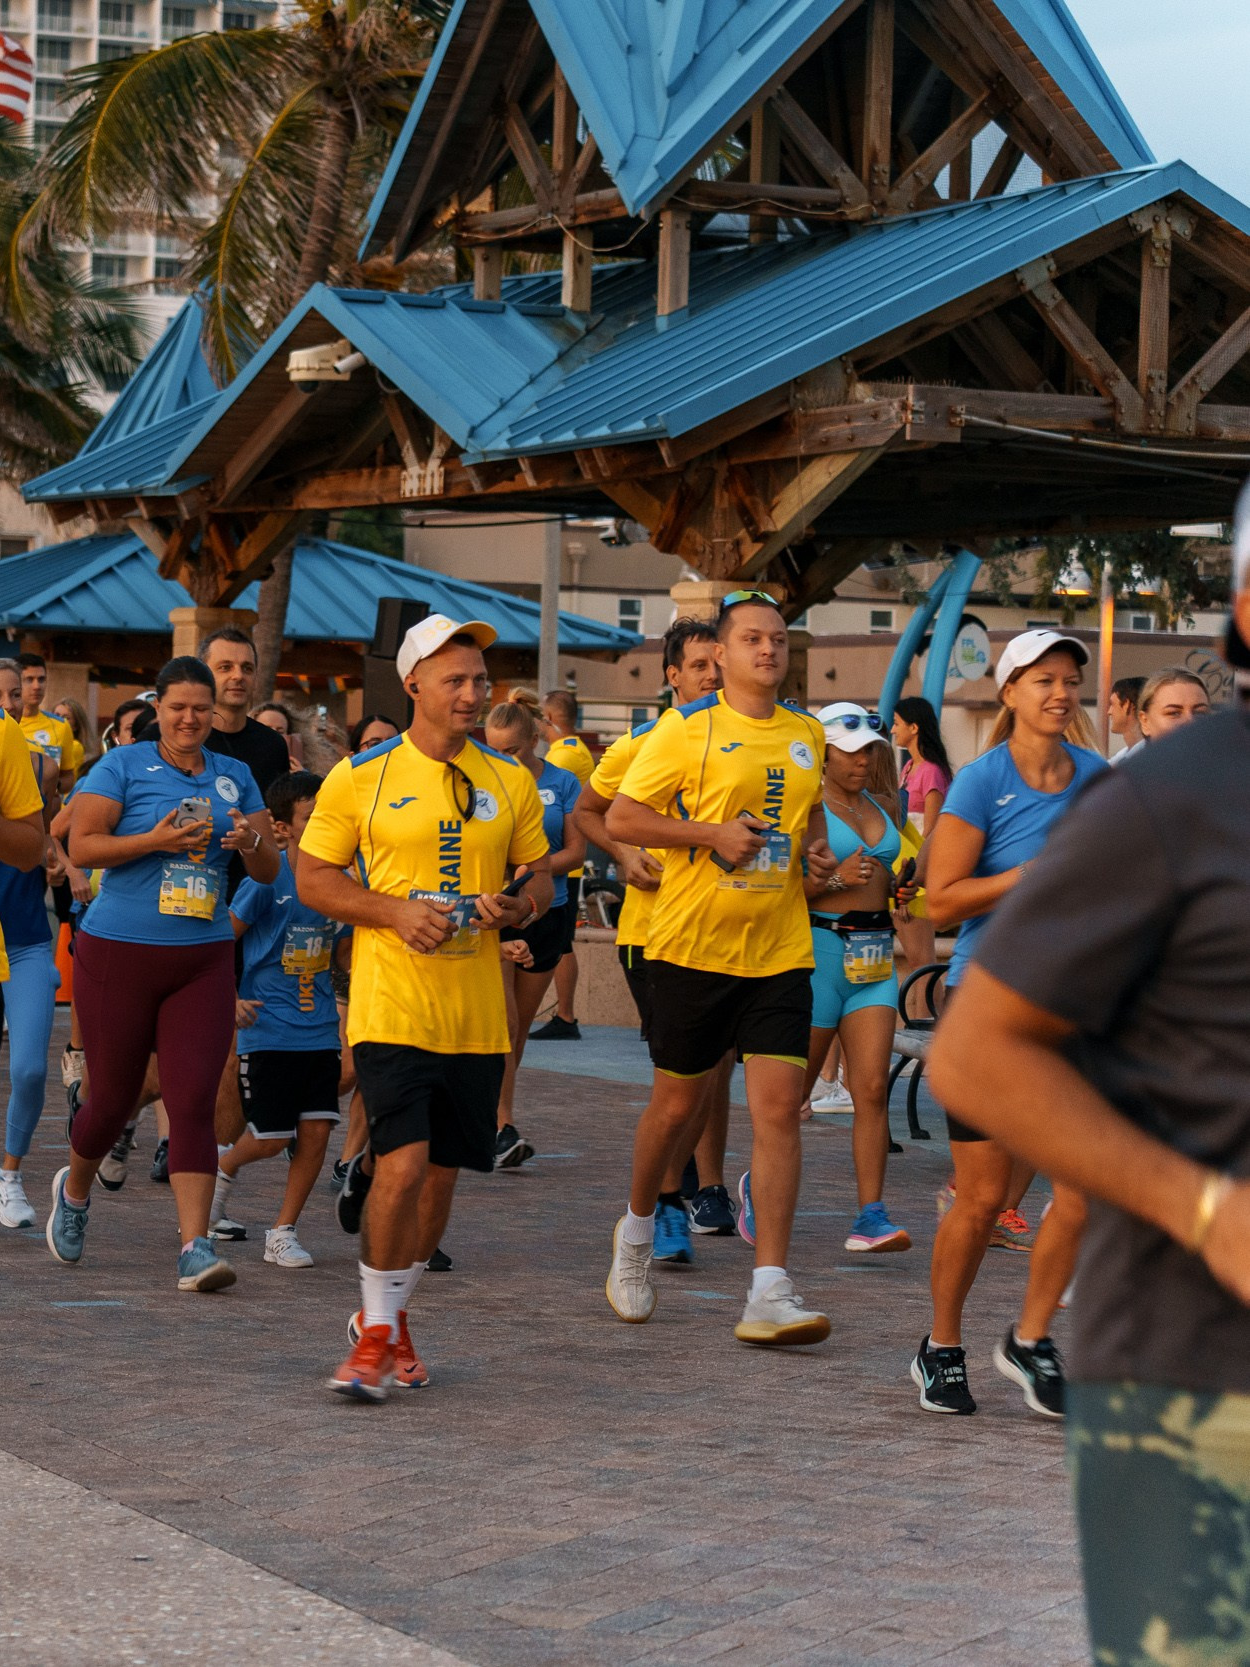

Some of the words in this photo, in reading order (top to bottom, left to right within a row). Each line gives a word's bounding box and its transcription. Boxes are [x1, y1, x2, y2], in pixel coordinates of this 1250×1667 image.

[184, 876, 207, 900] 16
[305, 936, 324, 957] 18
[860, 944, 883, 966] 171
